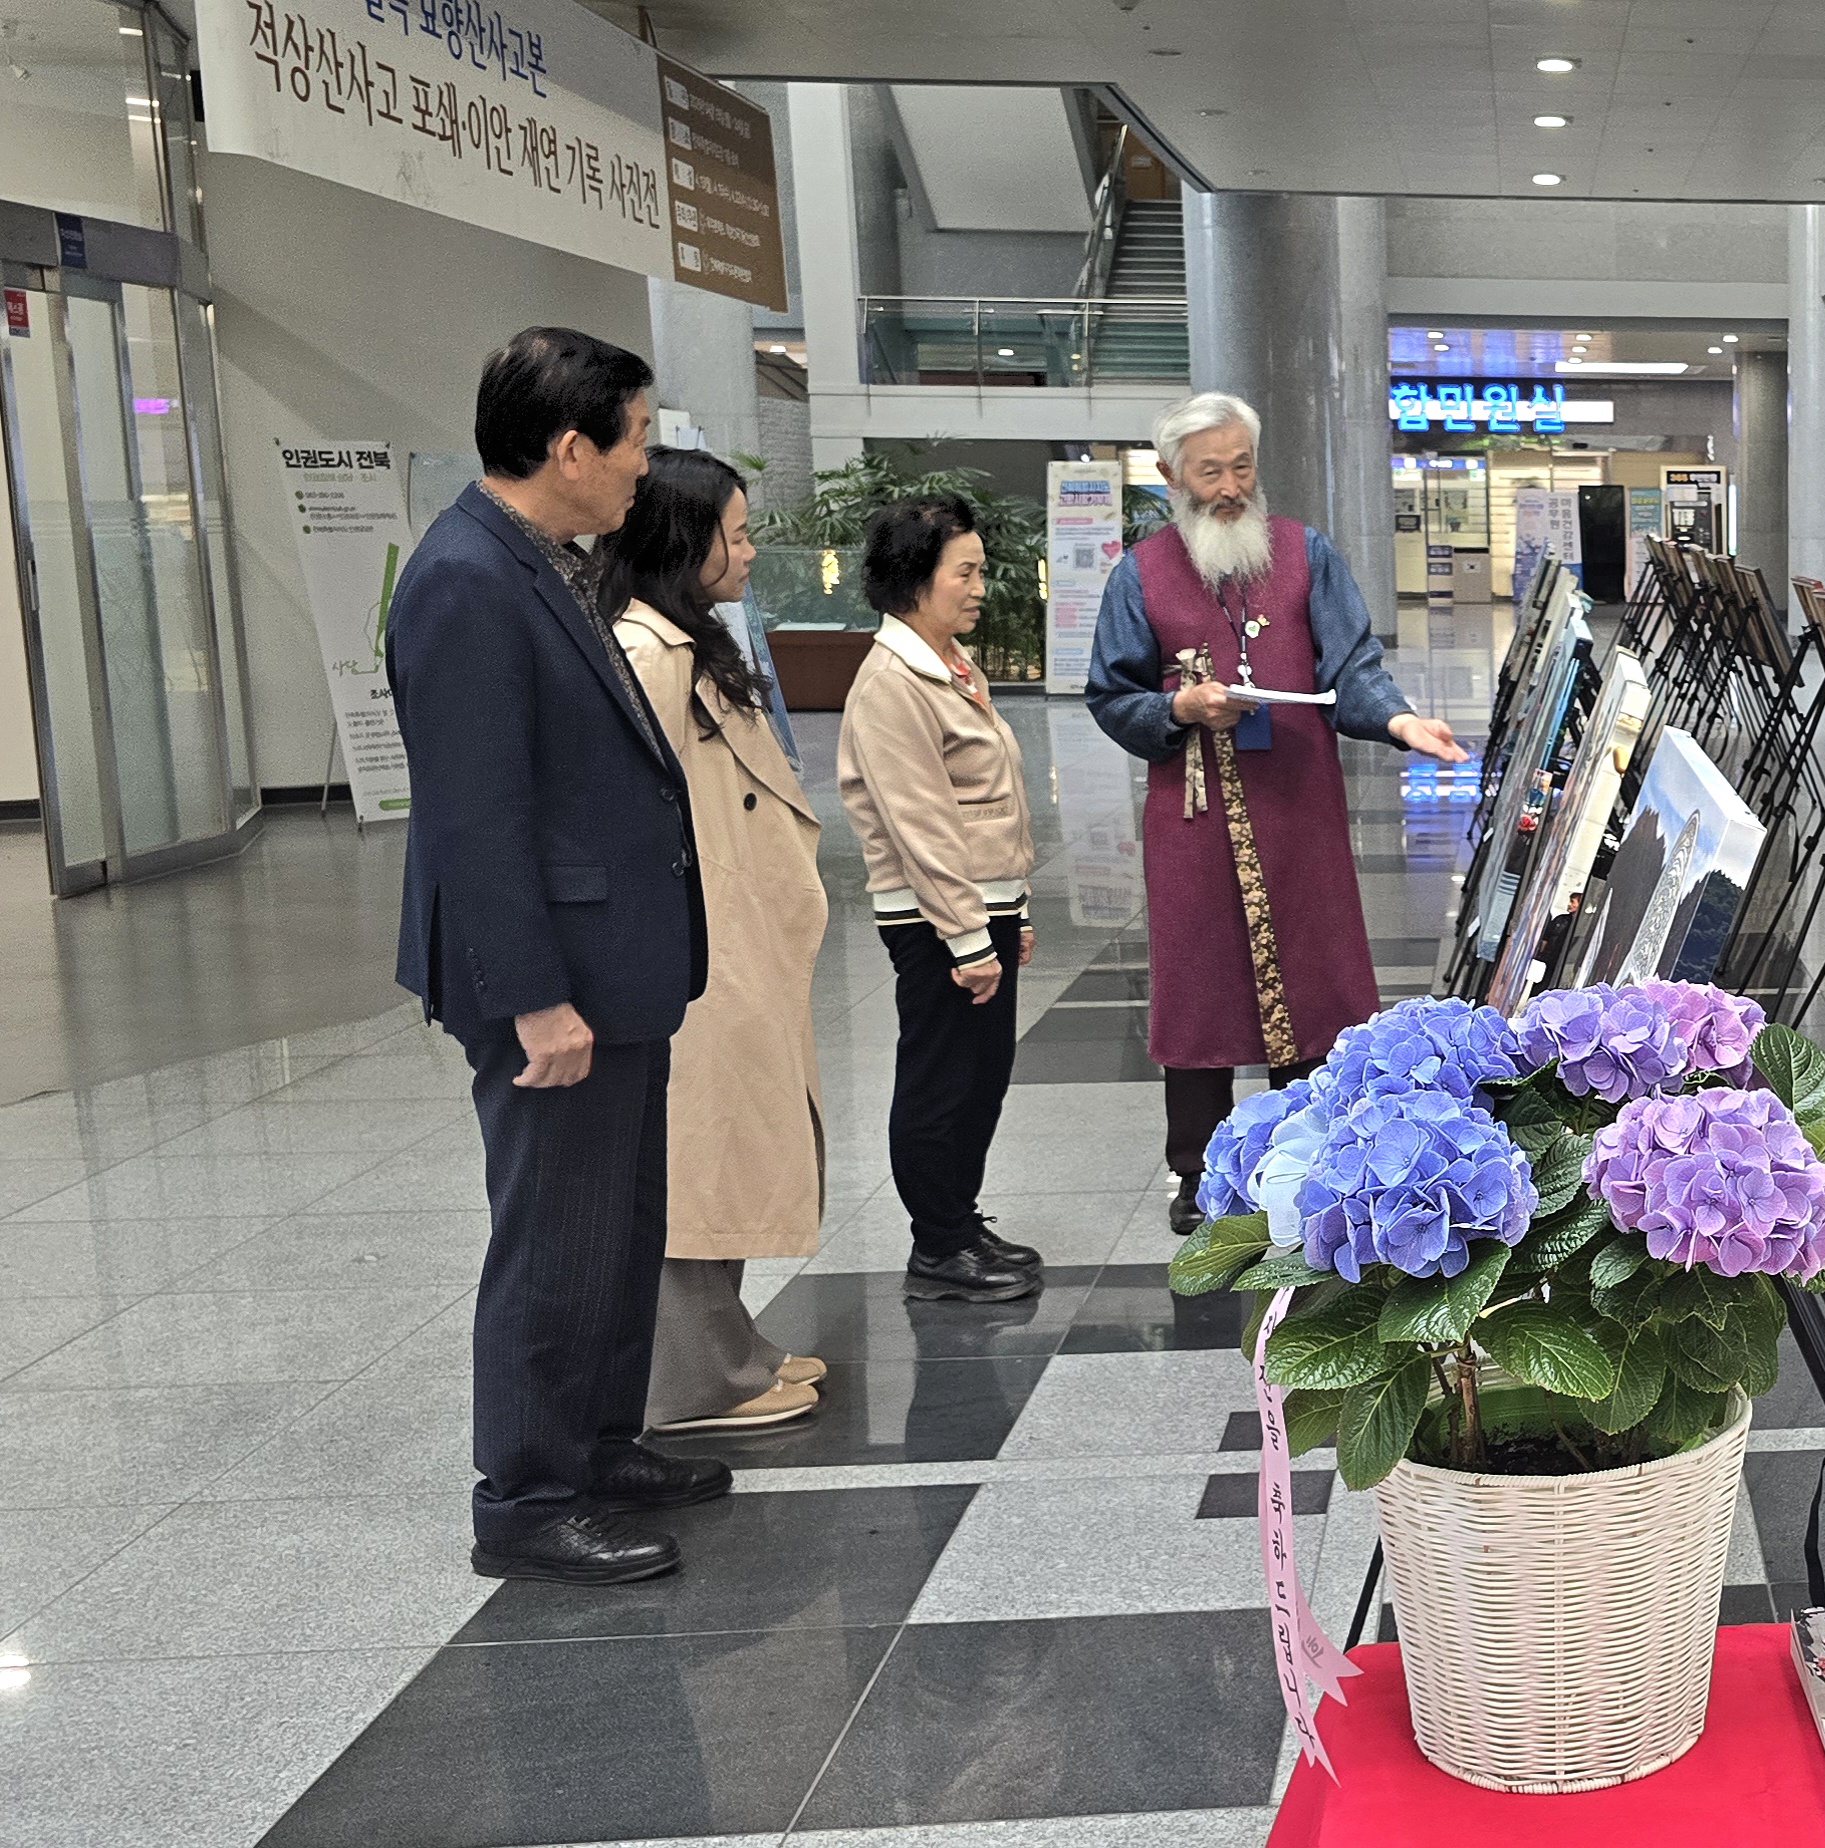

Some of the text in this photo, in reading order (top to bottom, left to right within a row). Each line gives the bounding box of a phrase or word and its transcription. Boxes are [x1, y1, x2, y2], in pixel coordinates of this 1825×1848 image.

[247, 0, 404, 127] 적상산사고
[408, 75, 514, 177] 포쇄·이안
[518, 116, 561, 194] 재연
[565, 136, 603, 211] 기록
[609, 153, 661, 230] 사진전
[282, 449, 391, 470] 인권도시 전북
